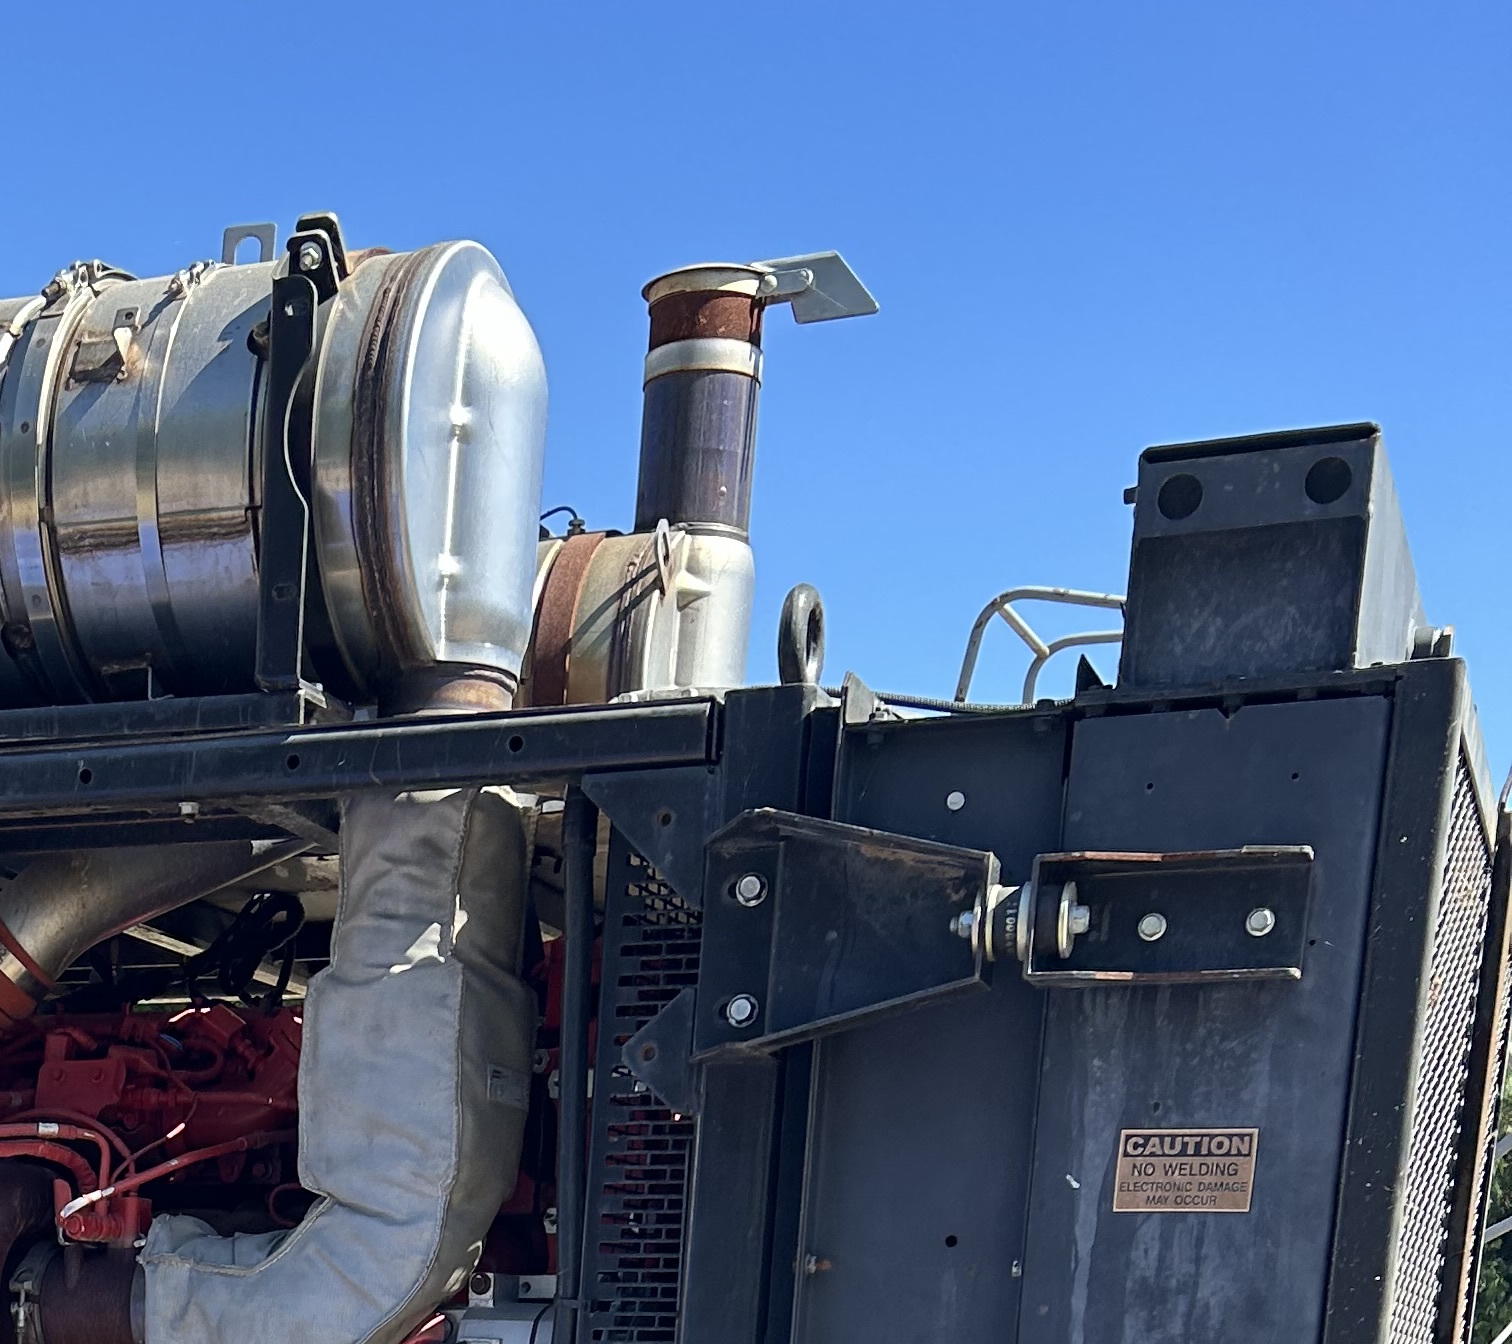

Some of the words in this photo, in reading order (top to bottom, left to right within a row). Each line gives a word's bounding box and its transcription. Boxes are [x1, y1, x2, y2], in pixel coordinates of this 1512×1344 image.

[1125, 1135, 1251, 1156] CAUTION
[1131, 1162, 1156, 1177] NO
[1163, 1162, 1239, 1177] WELDING
[1119, 1181, 1193, 1193] ELECTRONIC
[1197, 1181, 1248, 1193] DAMAGE
[1145, 1195, 1170, 1206] MAY
[1174, 1195, 1218, 1206] OCCUR
